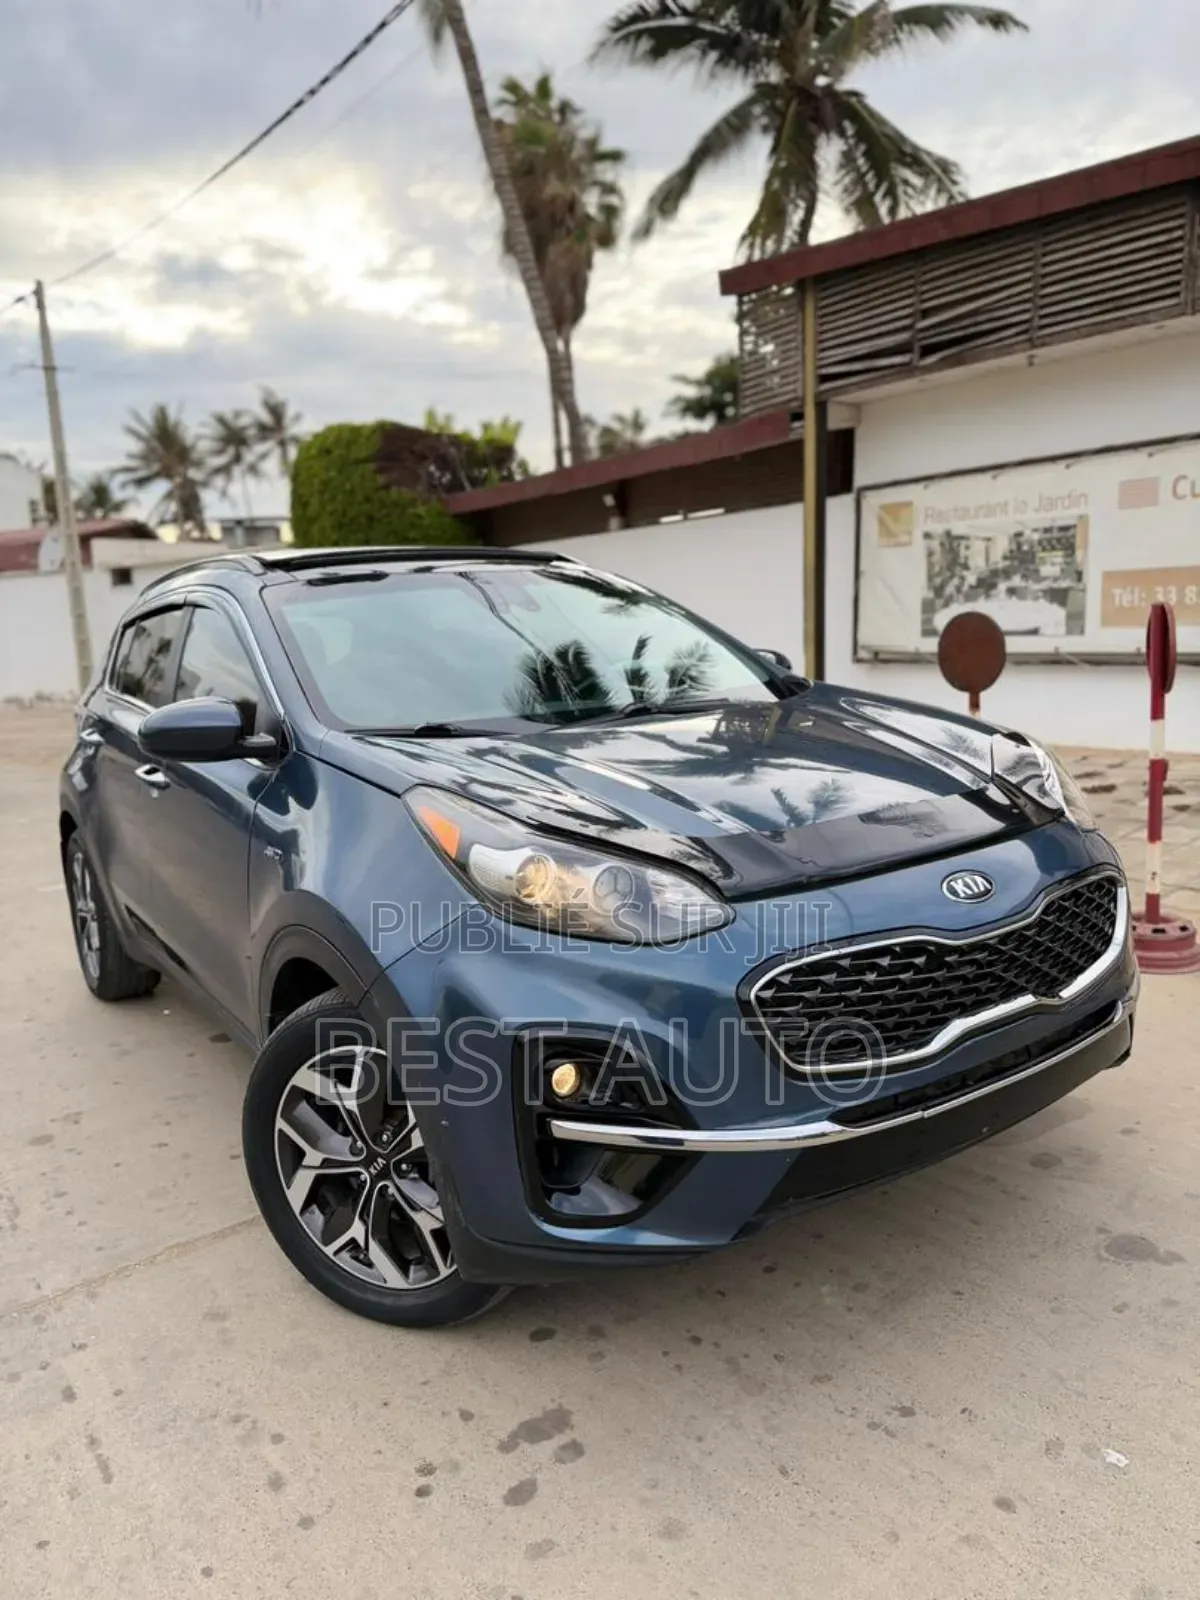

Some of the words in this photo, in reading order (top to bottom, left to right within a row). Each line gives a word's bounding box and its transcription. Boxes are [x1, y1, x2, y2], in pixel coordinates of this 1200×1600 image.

[1033, 490, 1089, 513] Jardin
[950, 875, 992, 898] KIA
[369, 1157, 387, 1176] KIA
